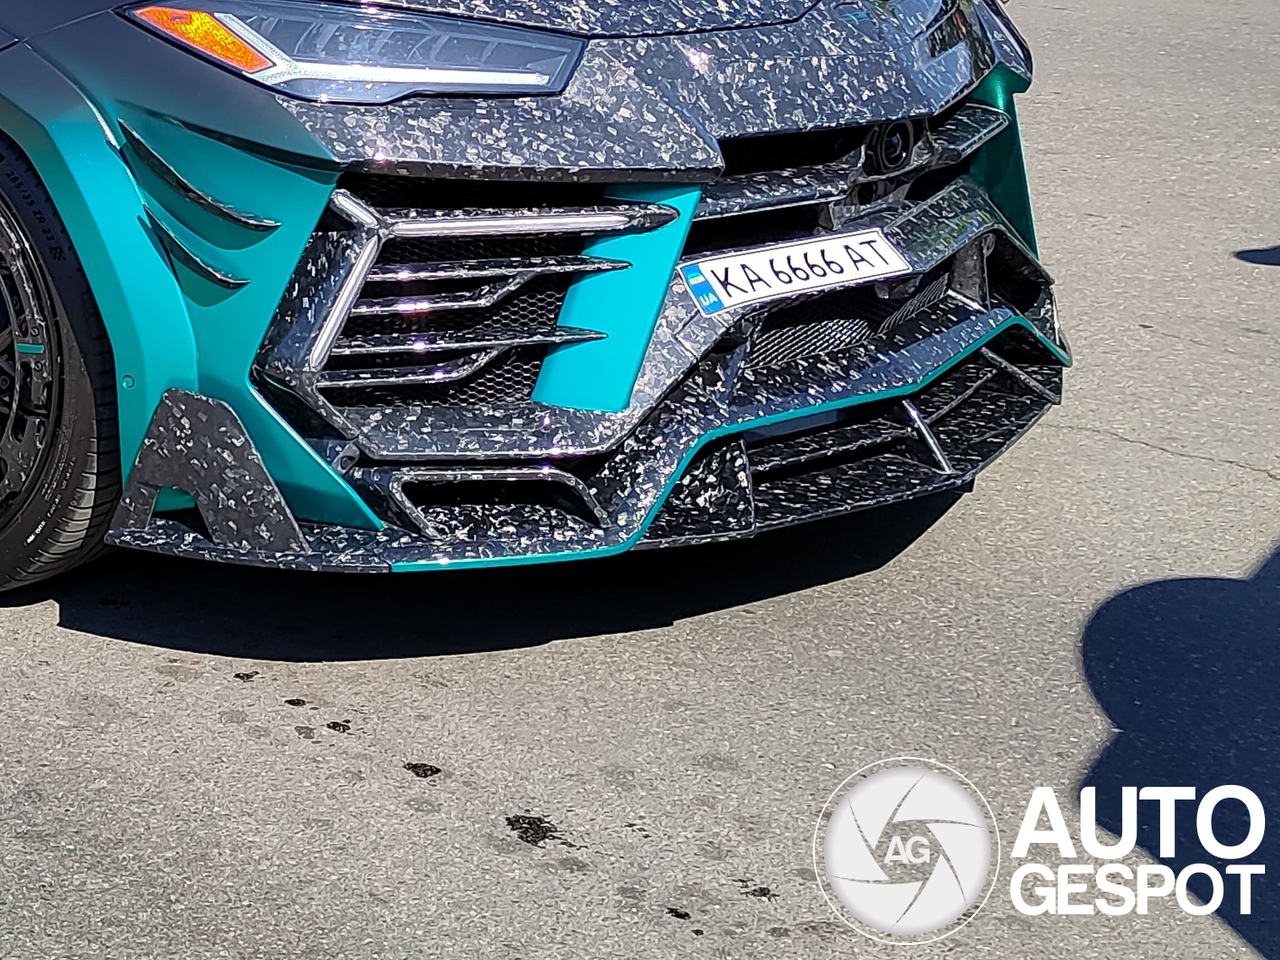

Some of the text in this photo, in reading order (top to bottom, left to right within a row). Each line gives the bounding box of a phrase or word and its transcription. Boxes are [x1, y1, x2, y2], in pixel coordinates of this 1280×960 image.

[5, 169, 36, 208] 285/35
[32, 208, 47, 226] ZR
[710, 239, 890, 298] KA 6666 AT
[699, 290, 719, 307] UA
